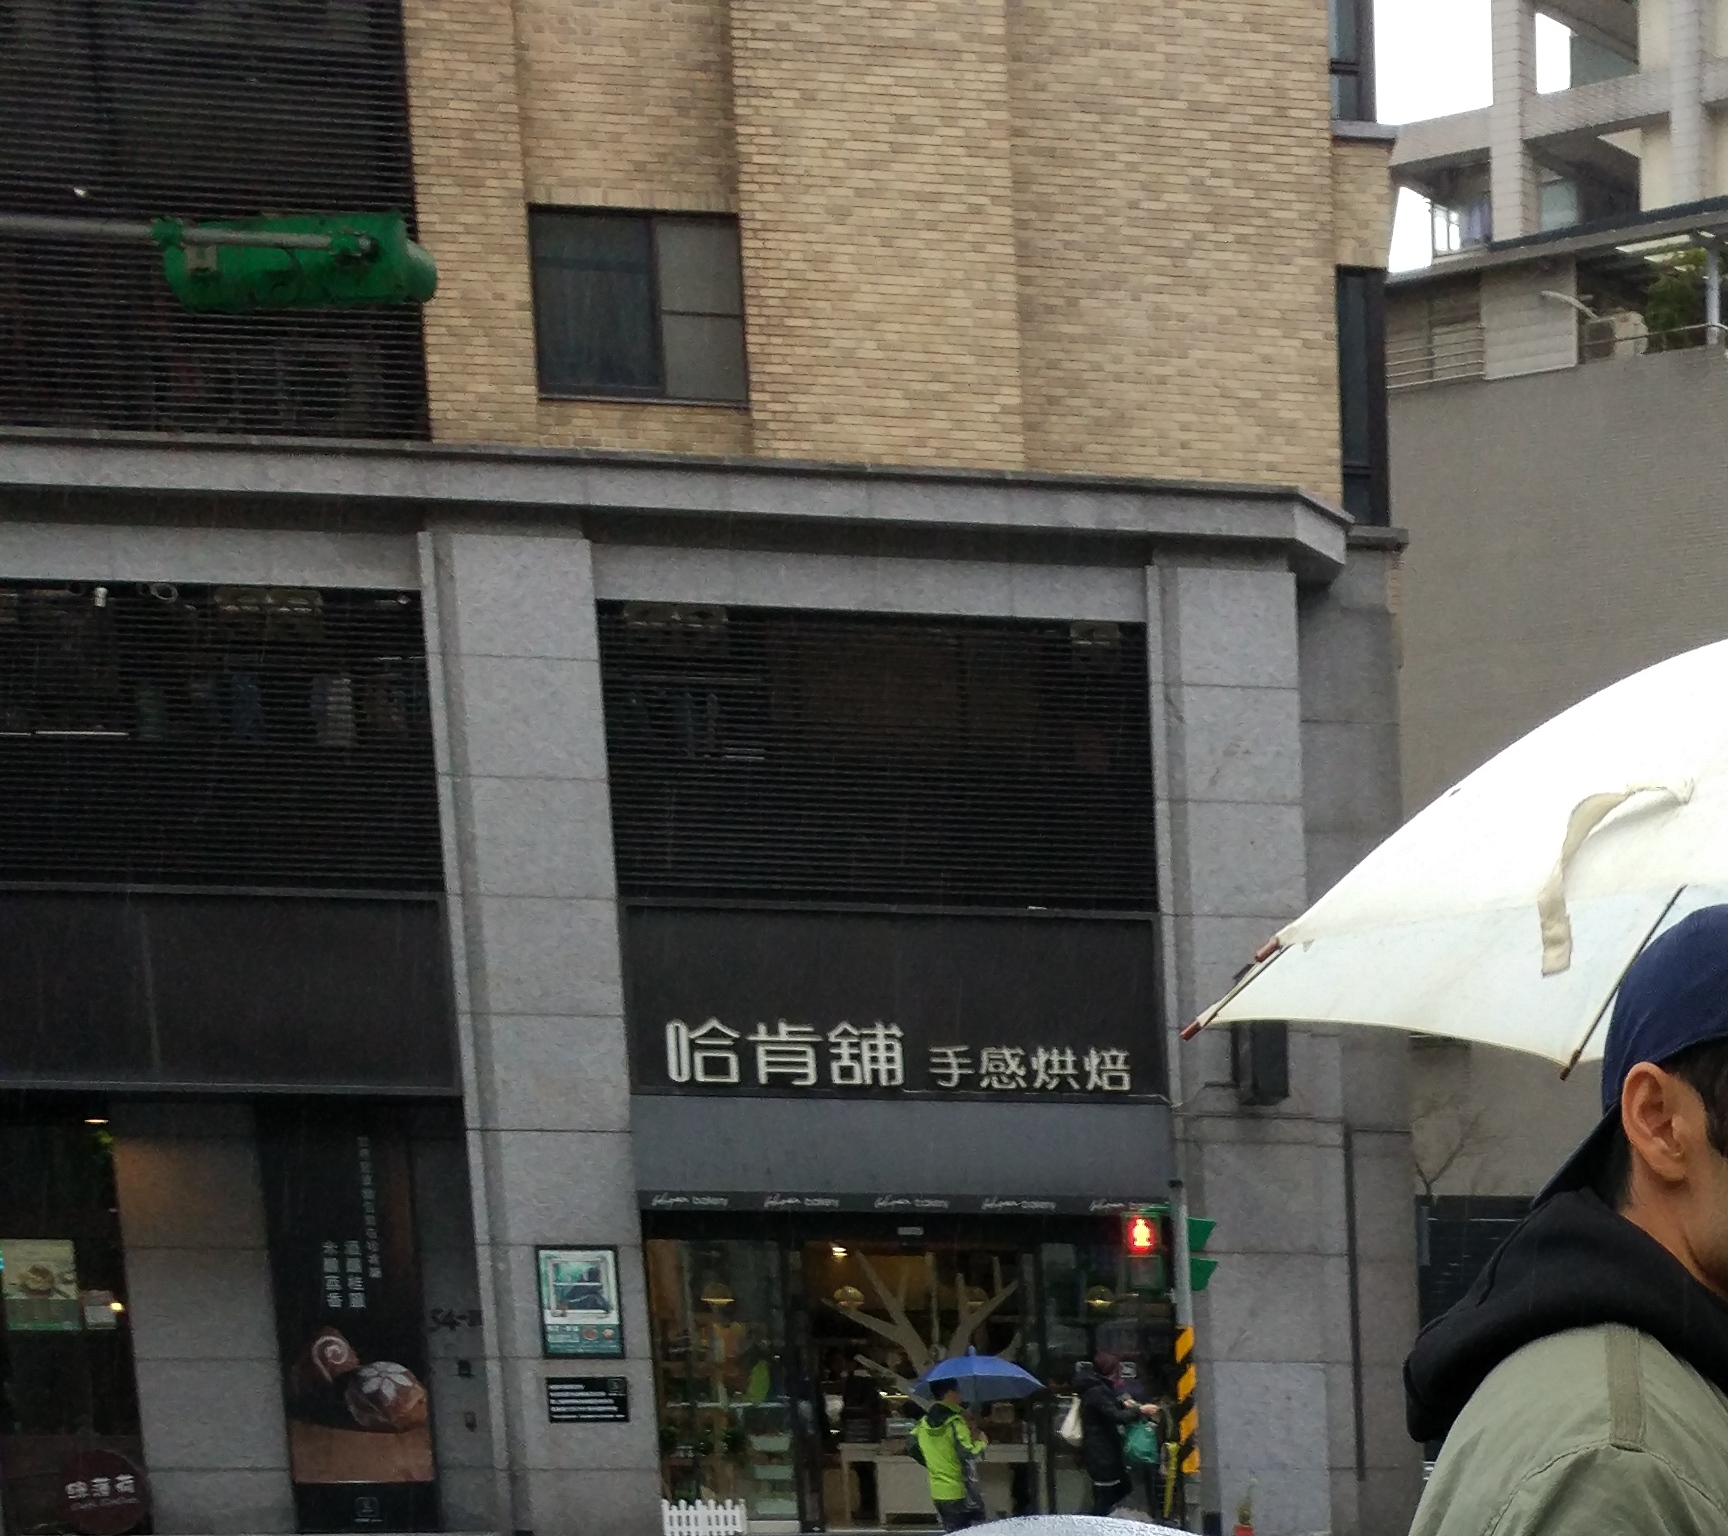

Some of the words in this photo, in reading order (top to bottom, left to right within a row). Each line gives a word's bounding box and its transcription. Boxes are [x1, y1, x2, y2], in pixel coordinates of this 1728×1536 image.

[665, 1017, 905, 1086] 哈肯舖
[928, 1045, 1132, 1091] 手感烘焙
